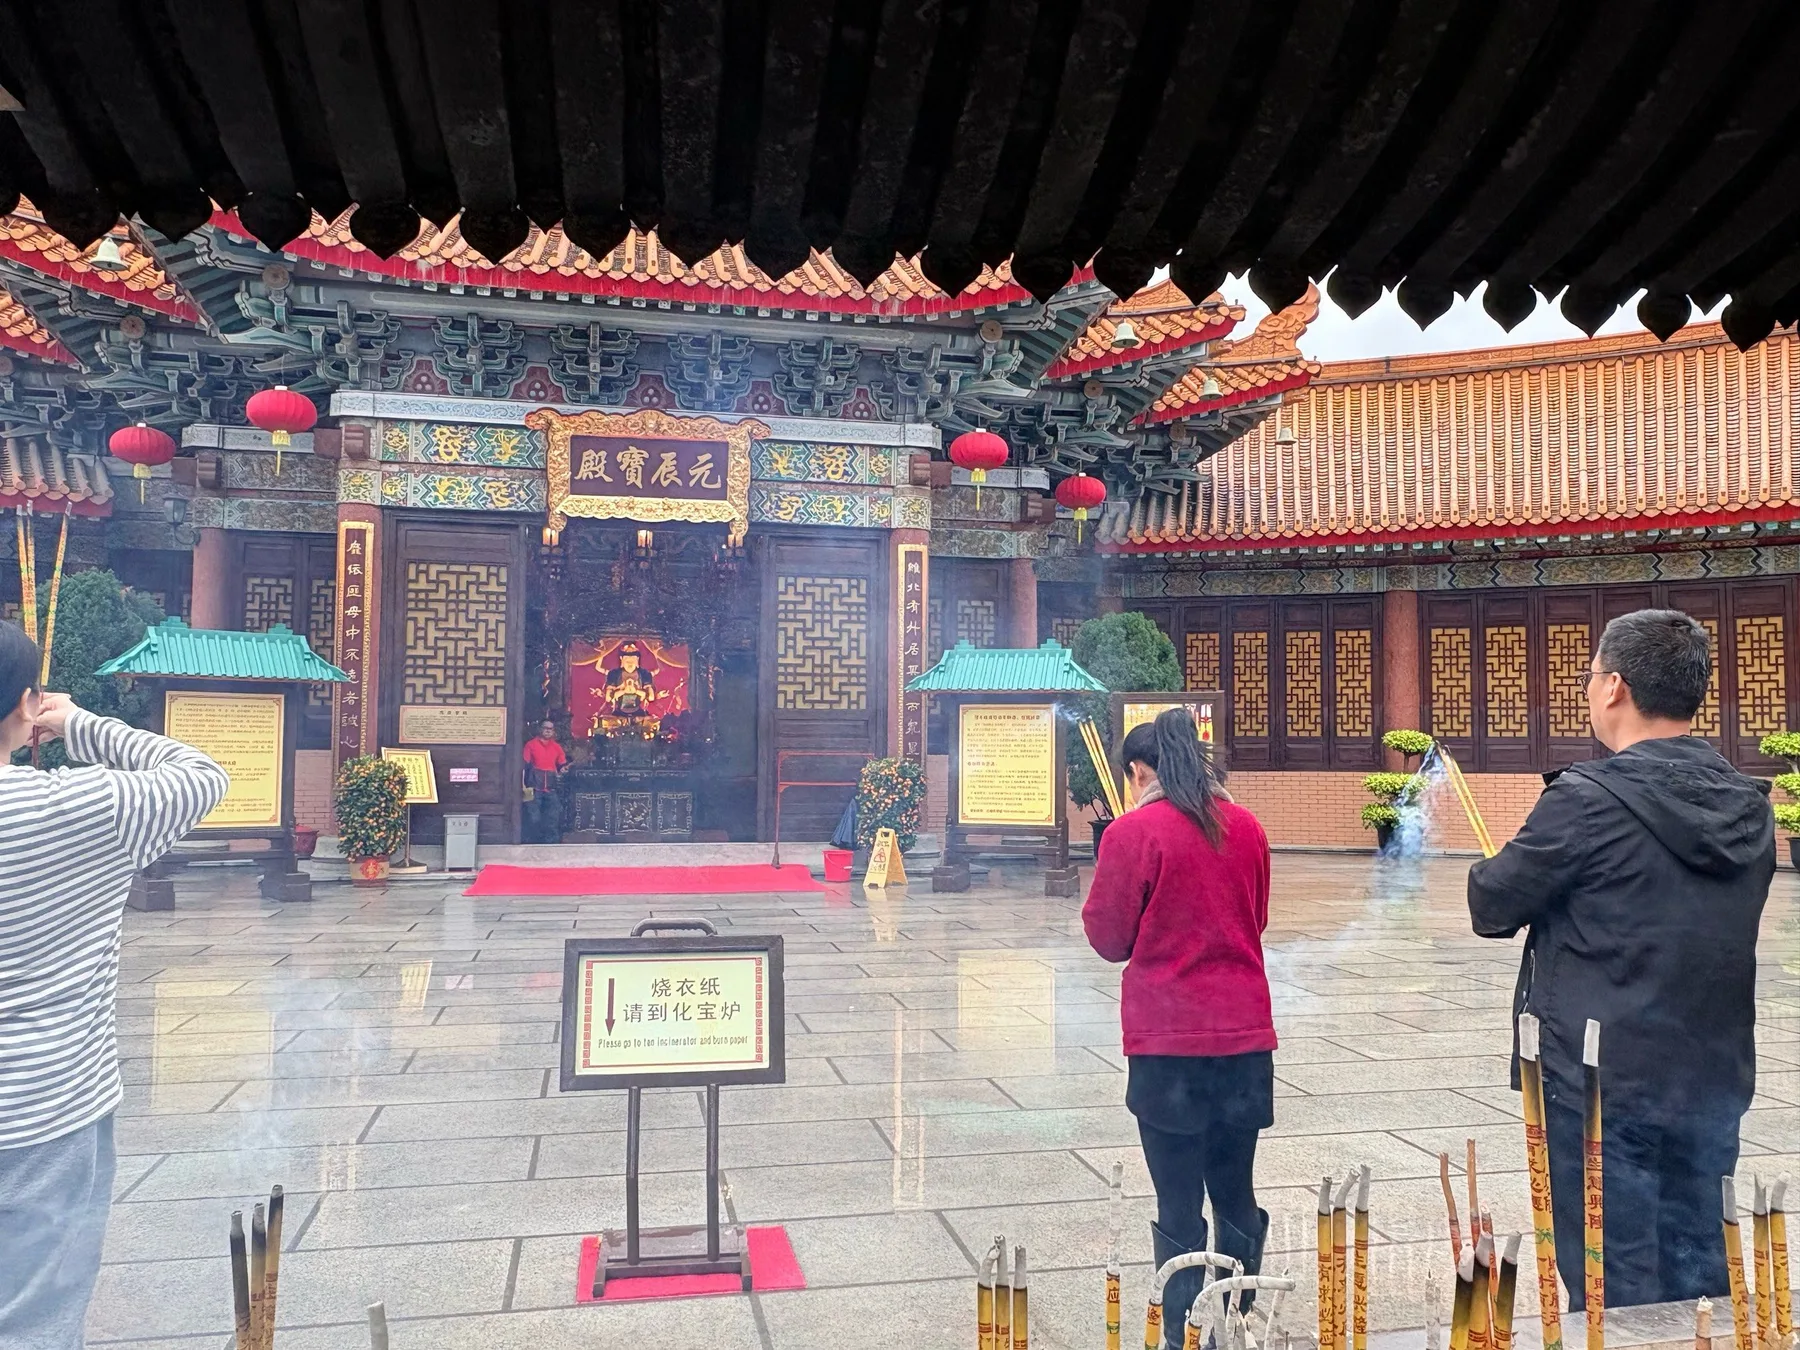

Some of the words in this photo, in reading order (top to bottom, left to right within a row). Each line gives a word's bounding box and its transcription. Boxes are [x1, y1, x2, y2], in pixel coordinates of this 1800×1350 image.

[574, 445, 722, 489] 元辰寶殿
[651, 976, 721, 998] 烧衣纸
[623, 1000, 742, 1024] 请到化宝炉
[598, 1038, 622, 1049] Please
[623, 1039, 632, 1049] go
[633, 1038, 642, 1048] to
[699, 1035, 712, 1045] and
